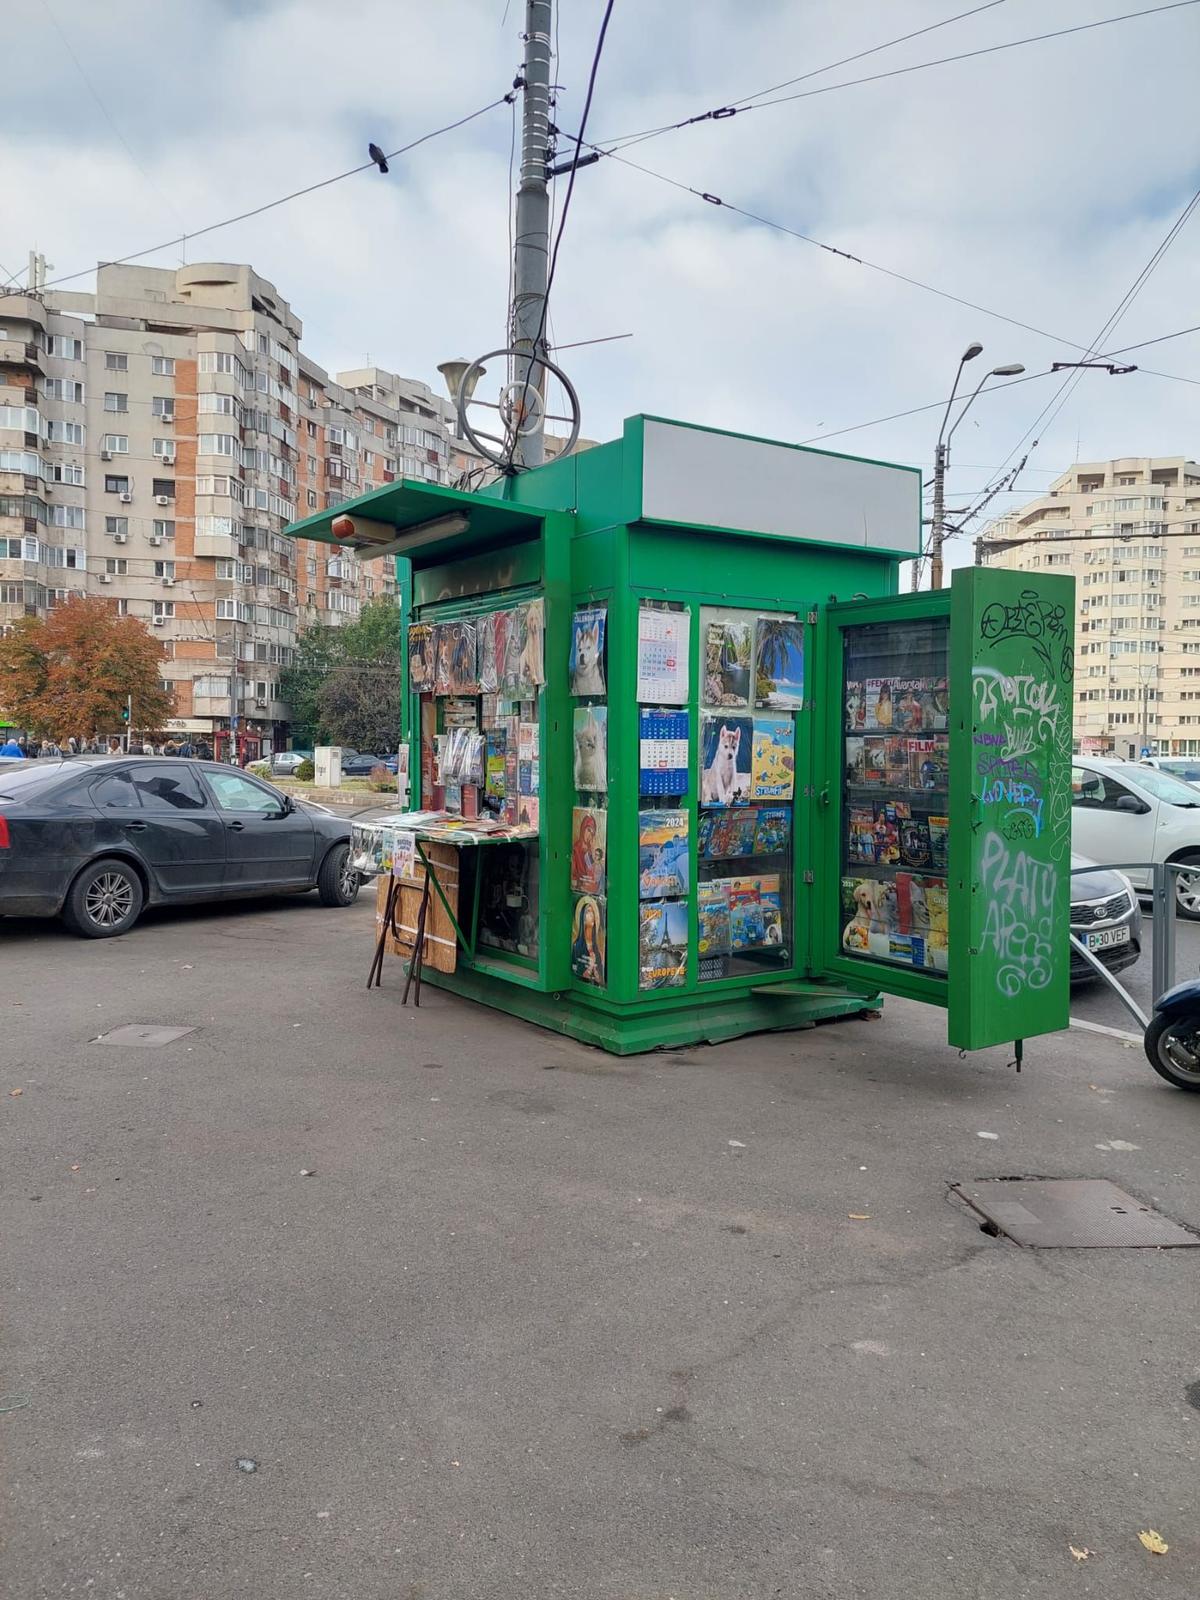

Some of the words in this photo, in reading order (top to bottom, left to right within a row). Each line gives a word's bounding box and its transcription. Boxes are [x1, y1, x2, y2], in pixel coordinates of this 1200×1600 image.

[908, 741, 934, 752] FILM
[665, 817, 684, 827] 2024
[1089, 935, 1096, 948] B
[1099, 932, 1109, 945] 30
[1110, 927, 1128, 943] VEF
[648, 967, 686, 979] EUROPEE
